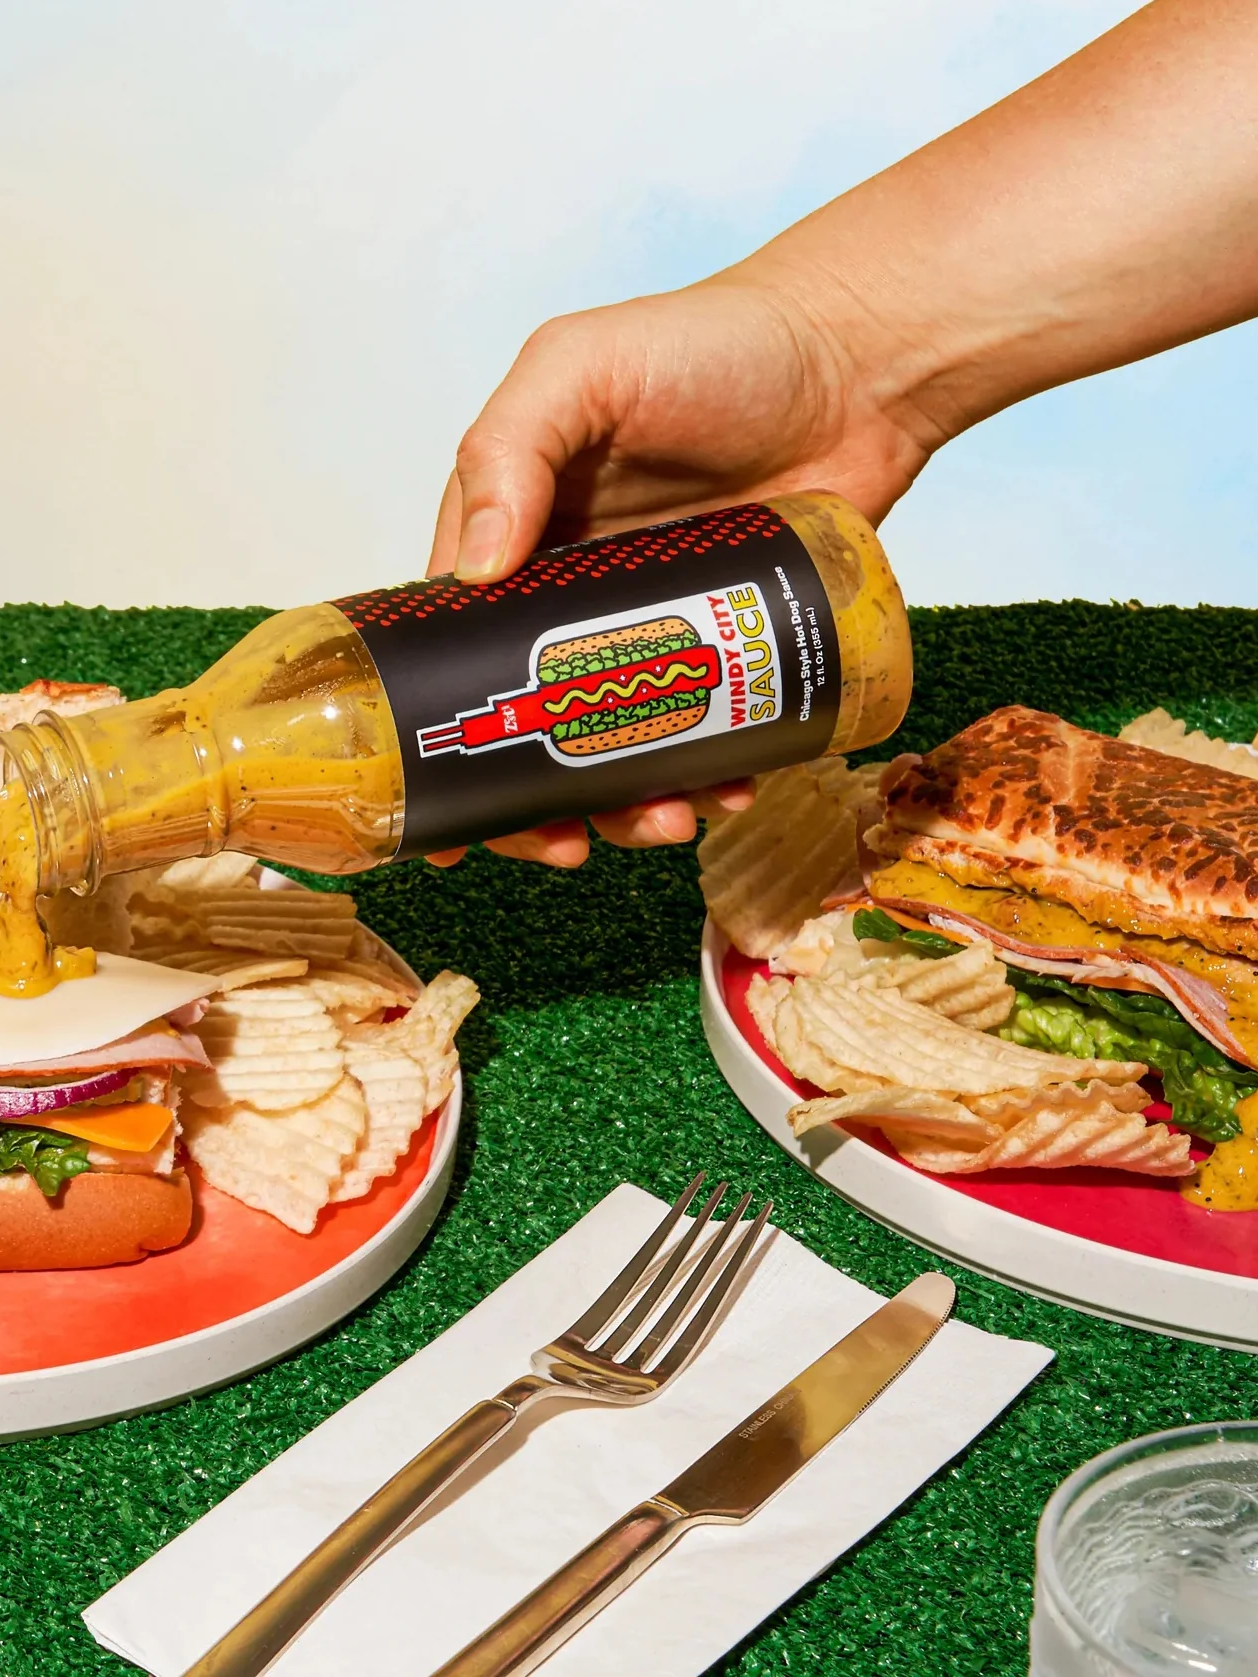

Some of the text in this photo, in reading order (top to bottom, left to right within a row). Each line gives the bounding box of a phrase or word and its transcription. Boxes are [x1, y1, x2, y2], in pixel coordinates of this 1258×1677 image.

[805, 607, 818, 626] mL)
[774, 566, 814, 721] Chicago Style Hot Dog Sauce
[810, 627, 823, 649] (355
[706, 595, 746, 728] WINDY CITY
[727, 587, 776, 721] SAUCE
[815, 651, 824, 665] Oz
[817, 676, 825, 687] 12
[738, 1409, 776, 1439] STAINLESS
